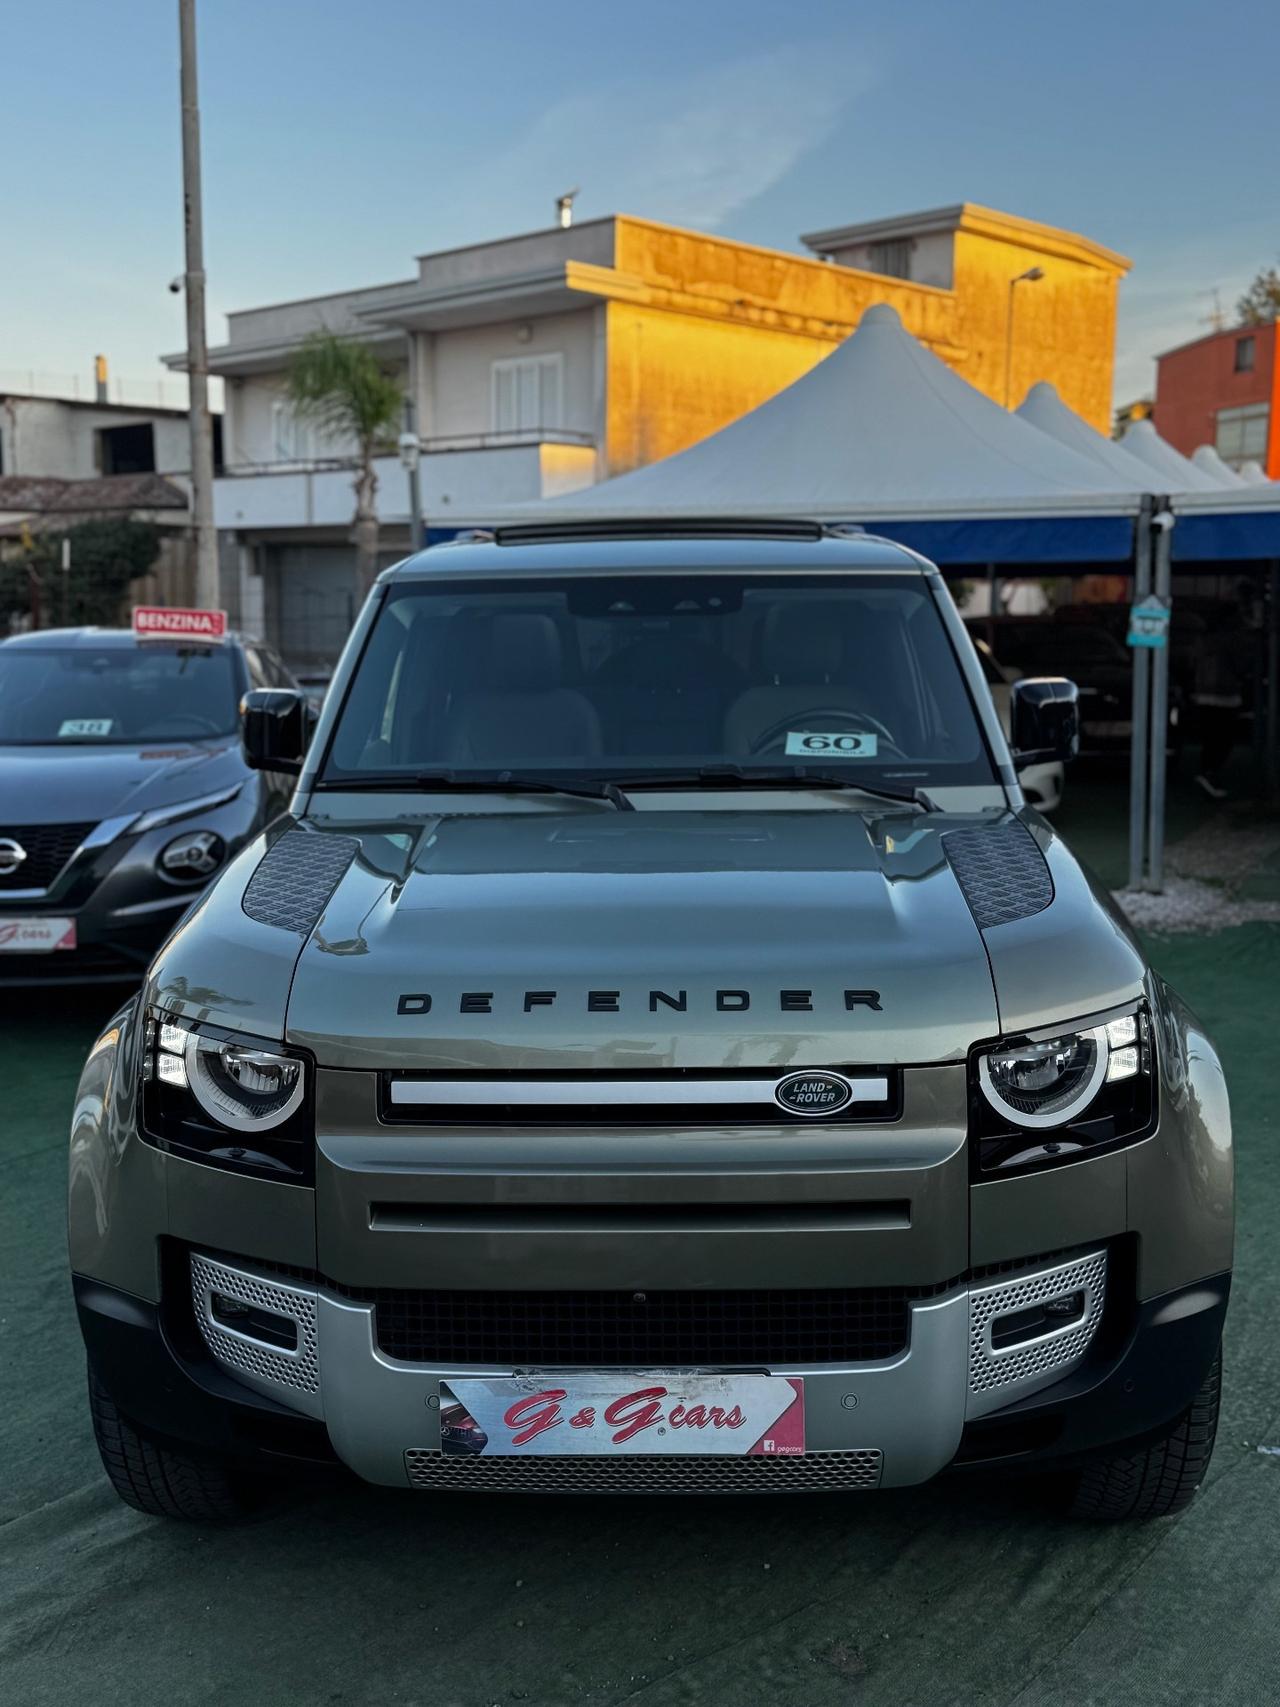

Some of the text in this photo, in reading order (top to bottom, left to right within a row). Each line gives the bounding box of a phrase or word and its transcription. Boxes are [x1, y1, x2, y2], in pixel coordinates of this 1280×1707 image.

[137, 612, 212, 631] BENZINA
[802, 736, 862, 750] 60
[397, 989, 884, 1015] DEFENDER
[503, 1386, 747, 1446] G & G cars
